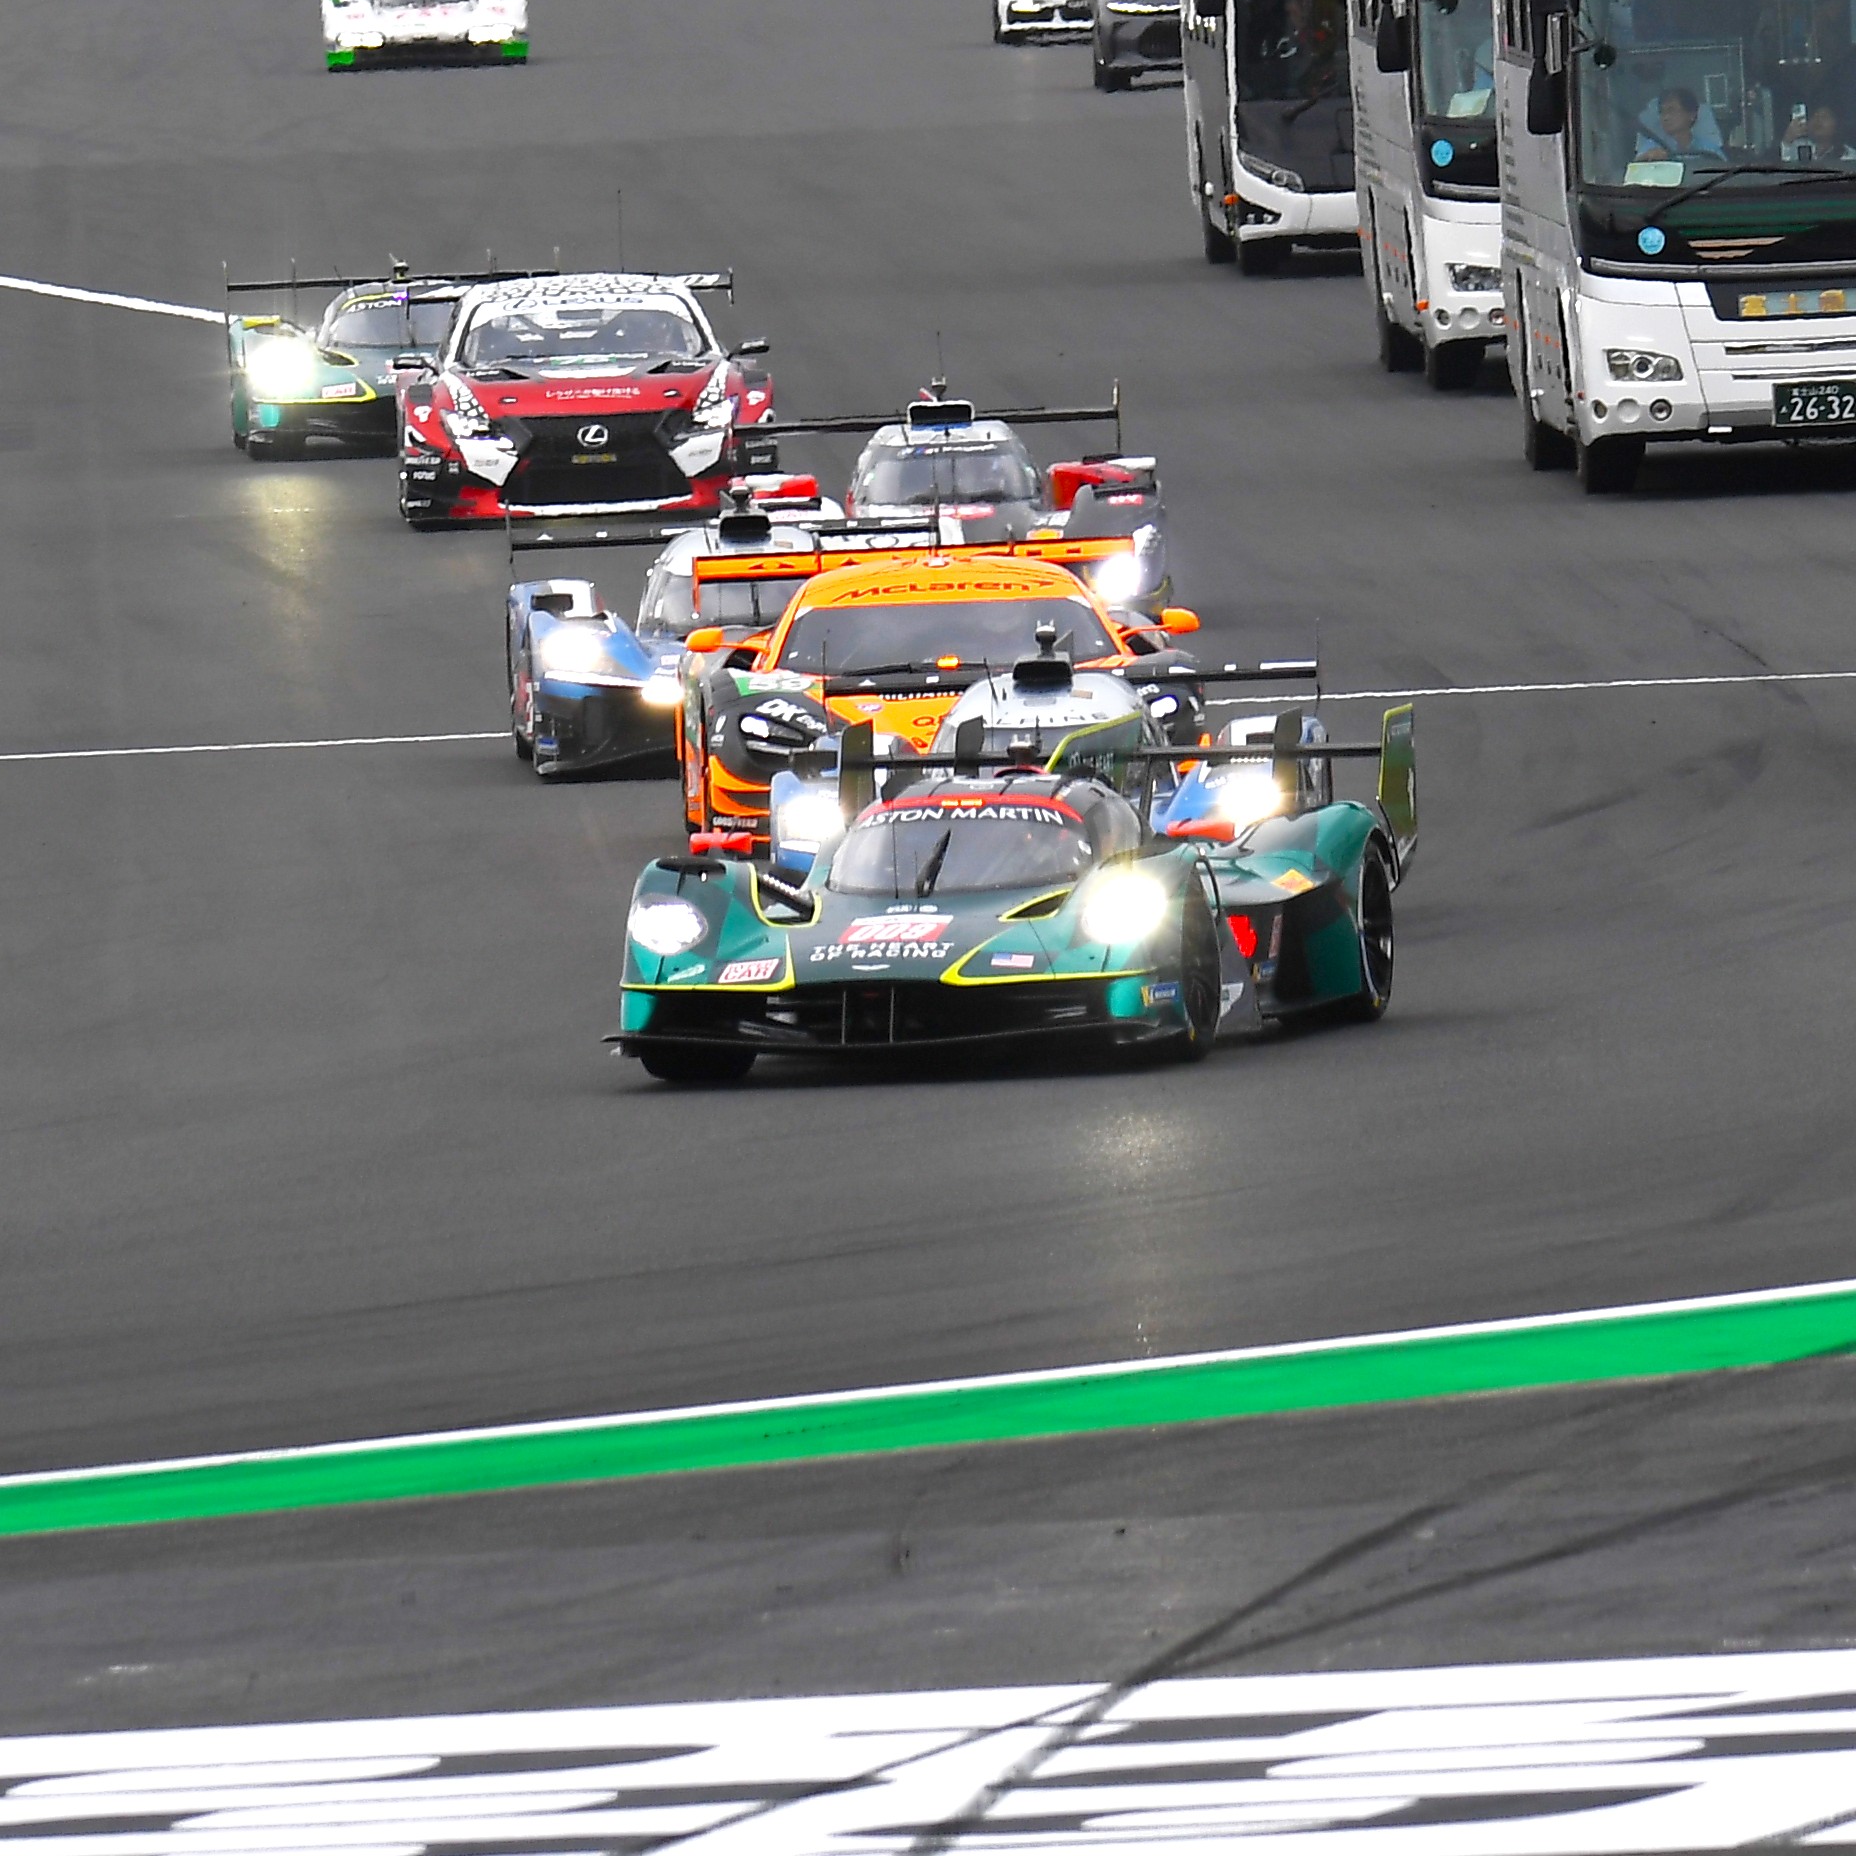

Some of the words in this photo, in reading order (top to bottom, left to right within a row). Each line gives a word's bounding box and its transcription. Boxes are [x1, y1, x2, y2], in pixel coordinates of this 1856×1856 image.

[347, 299, 402, 313] ASTON
[1790, 396, 1856, 421] 26-32
[832, 580, 1055, 602] McLaren
[860, 806, 944, 829] ASTON
[950, 806, 1064, 825] MARTIN
[811, 943, 860, 953] THE
[870, 941, 955, 952] HEART
[850, 949, 948, 960] RACING
